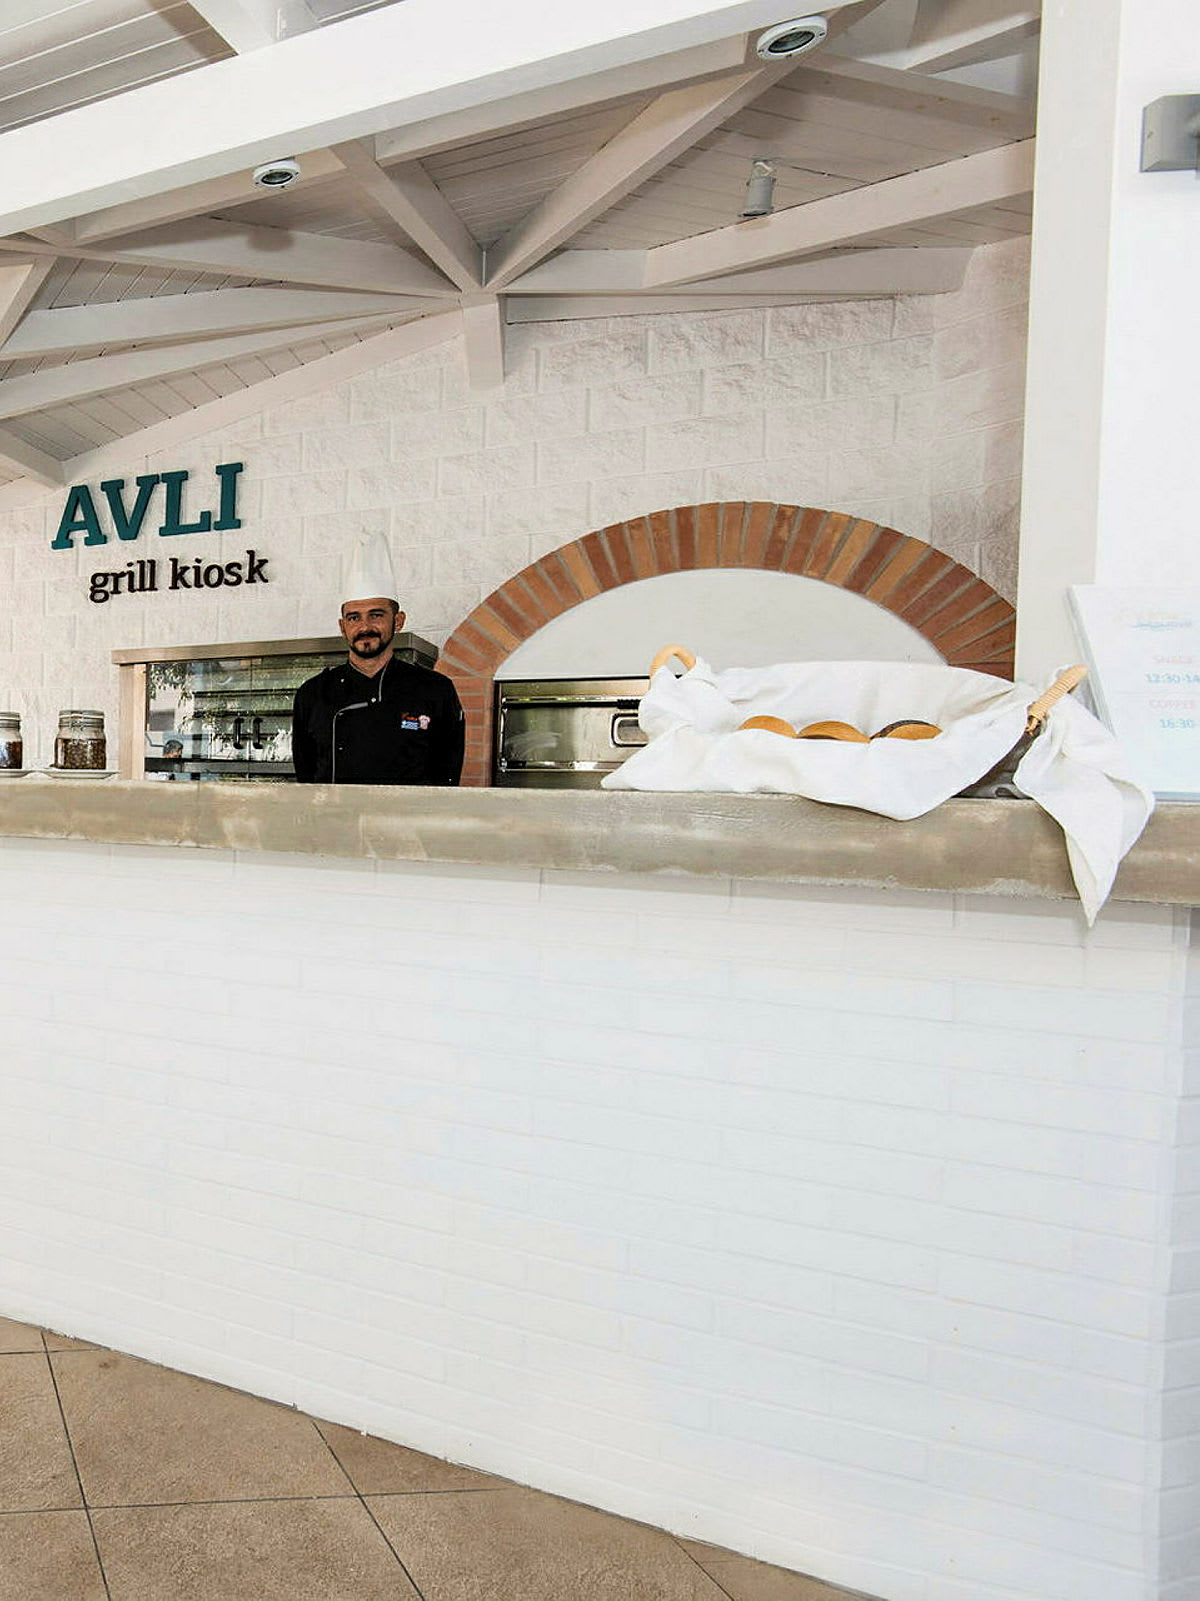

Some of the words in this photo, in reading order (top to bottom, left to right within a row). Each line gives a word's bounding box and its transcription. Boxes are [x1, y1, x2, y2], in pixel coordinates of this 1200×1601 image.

[51, 462, 243, 550] AVLI
[89, 559, 158, 604] grill
[169, 549, 269, 590] kiosk
